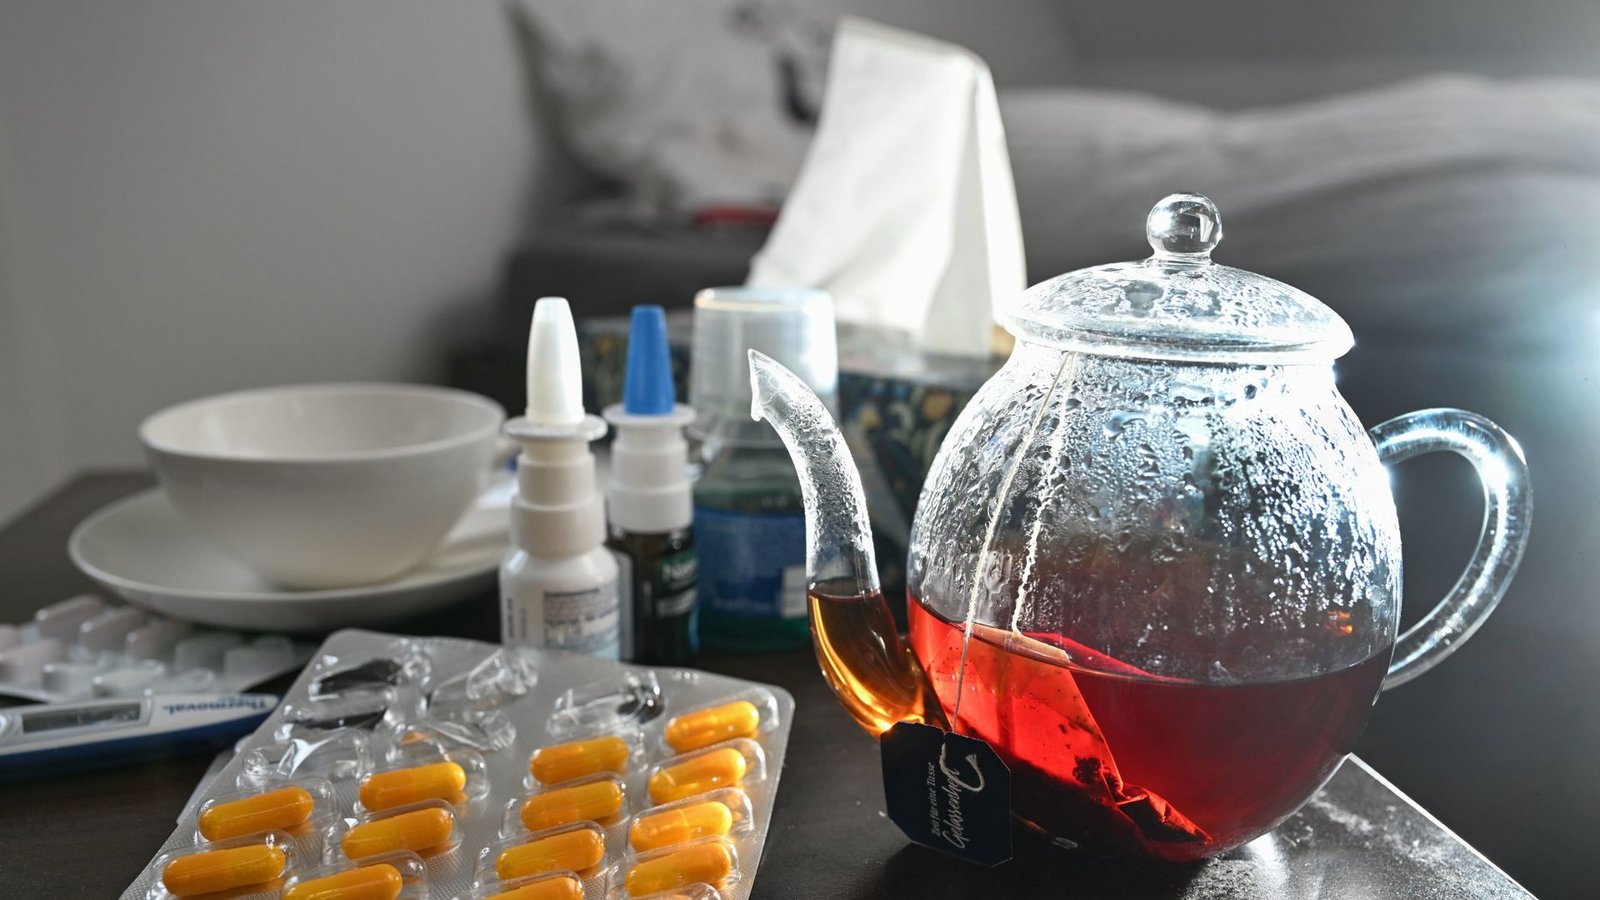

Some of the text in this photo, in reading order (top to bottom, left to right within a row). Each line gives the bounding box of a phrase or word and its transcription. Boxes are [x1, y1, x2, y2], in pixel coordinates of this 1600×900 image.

[926, 762, 941, 837] Zeit für eine Tasse
[941, 768, 970, 849] Gelassenhet
